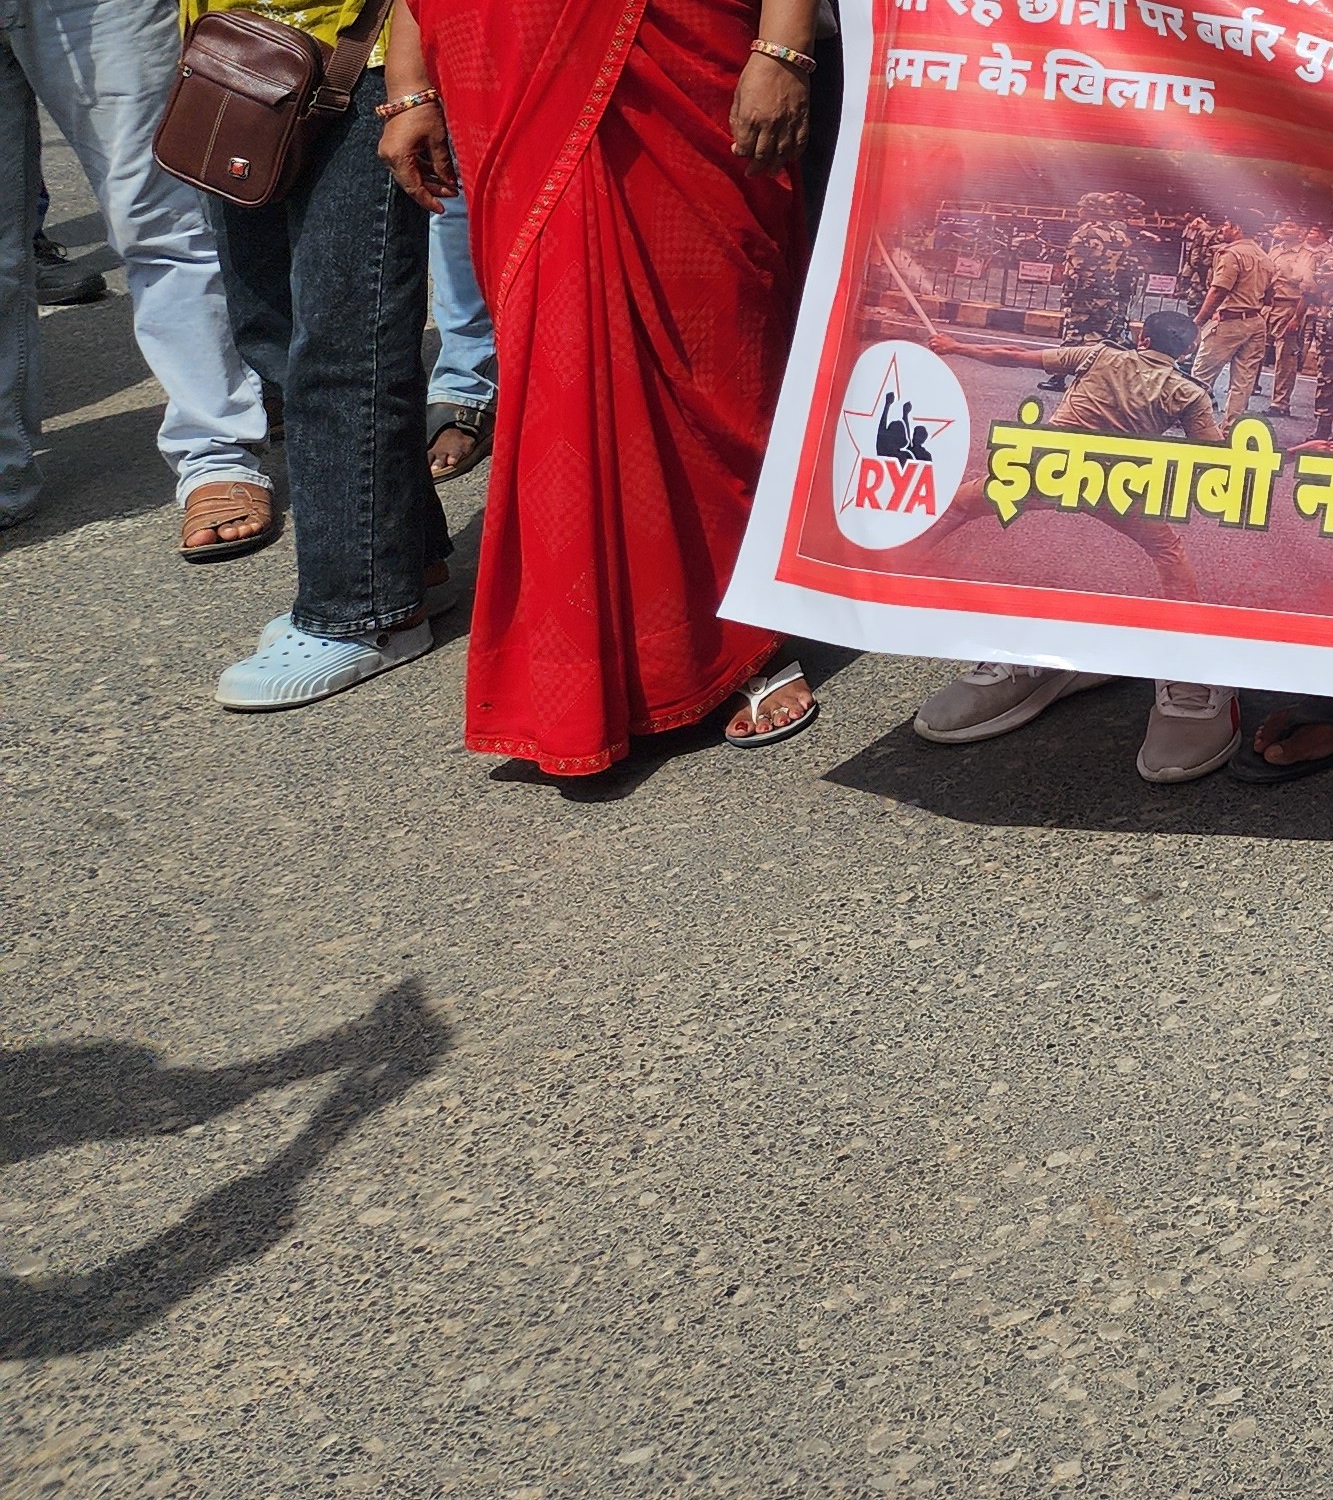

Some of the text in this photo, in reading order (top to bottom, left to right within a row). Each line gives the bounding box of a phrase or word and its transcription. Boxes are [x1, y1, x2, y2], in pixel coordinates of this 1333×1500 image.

[1192, 7, 1286, 62] बर्बर
[978, 42, 1033, 97] के
[1043, 48, 1216, 115] खिलाफ
[856, 459, 937, 516] RYA
[987, 400, 1282, 528] इंकलाबी
